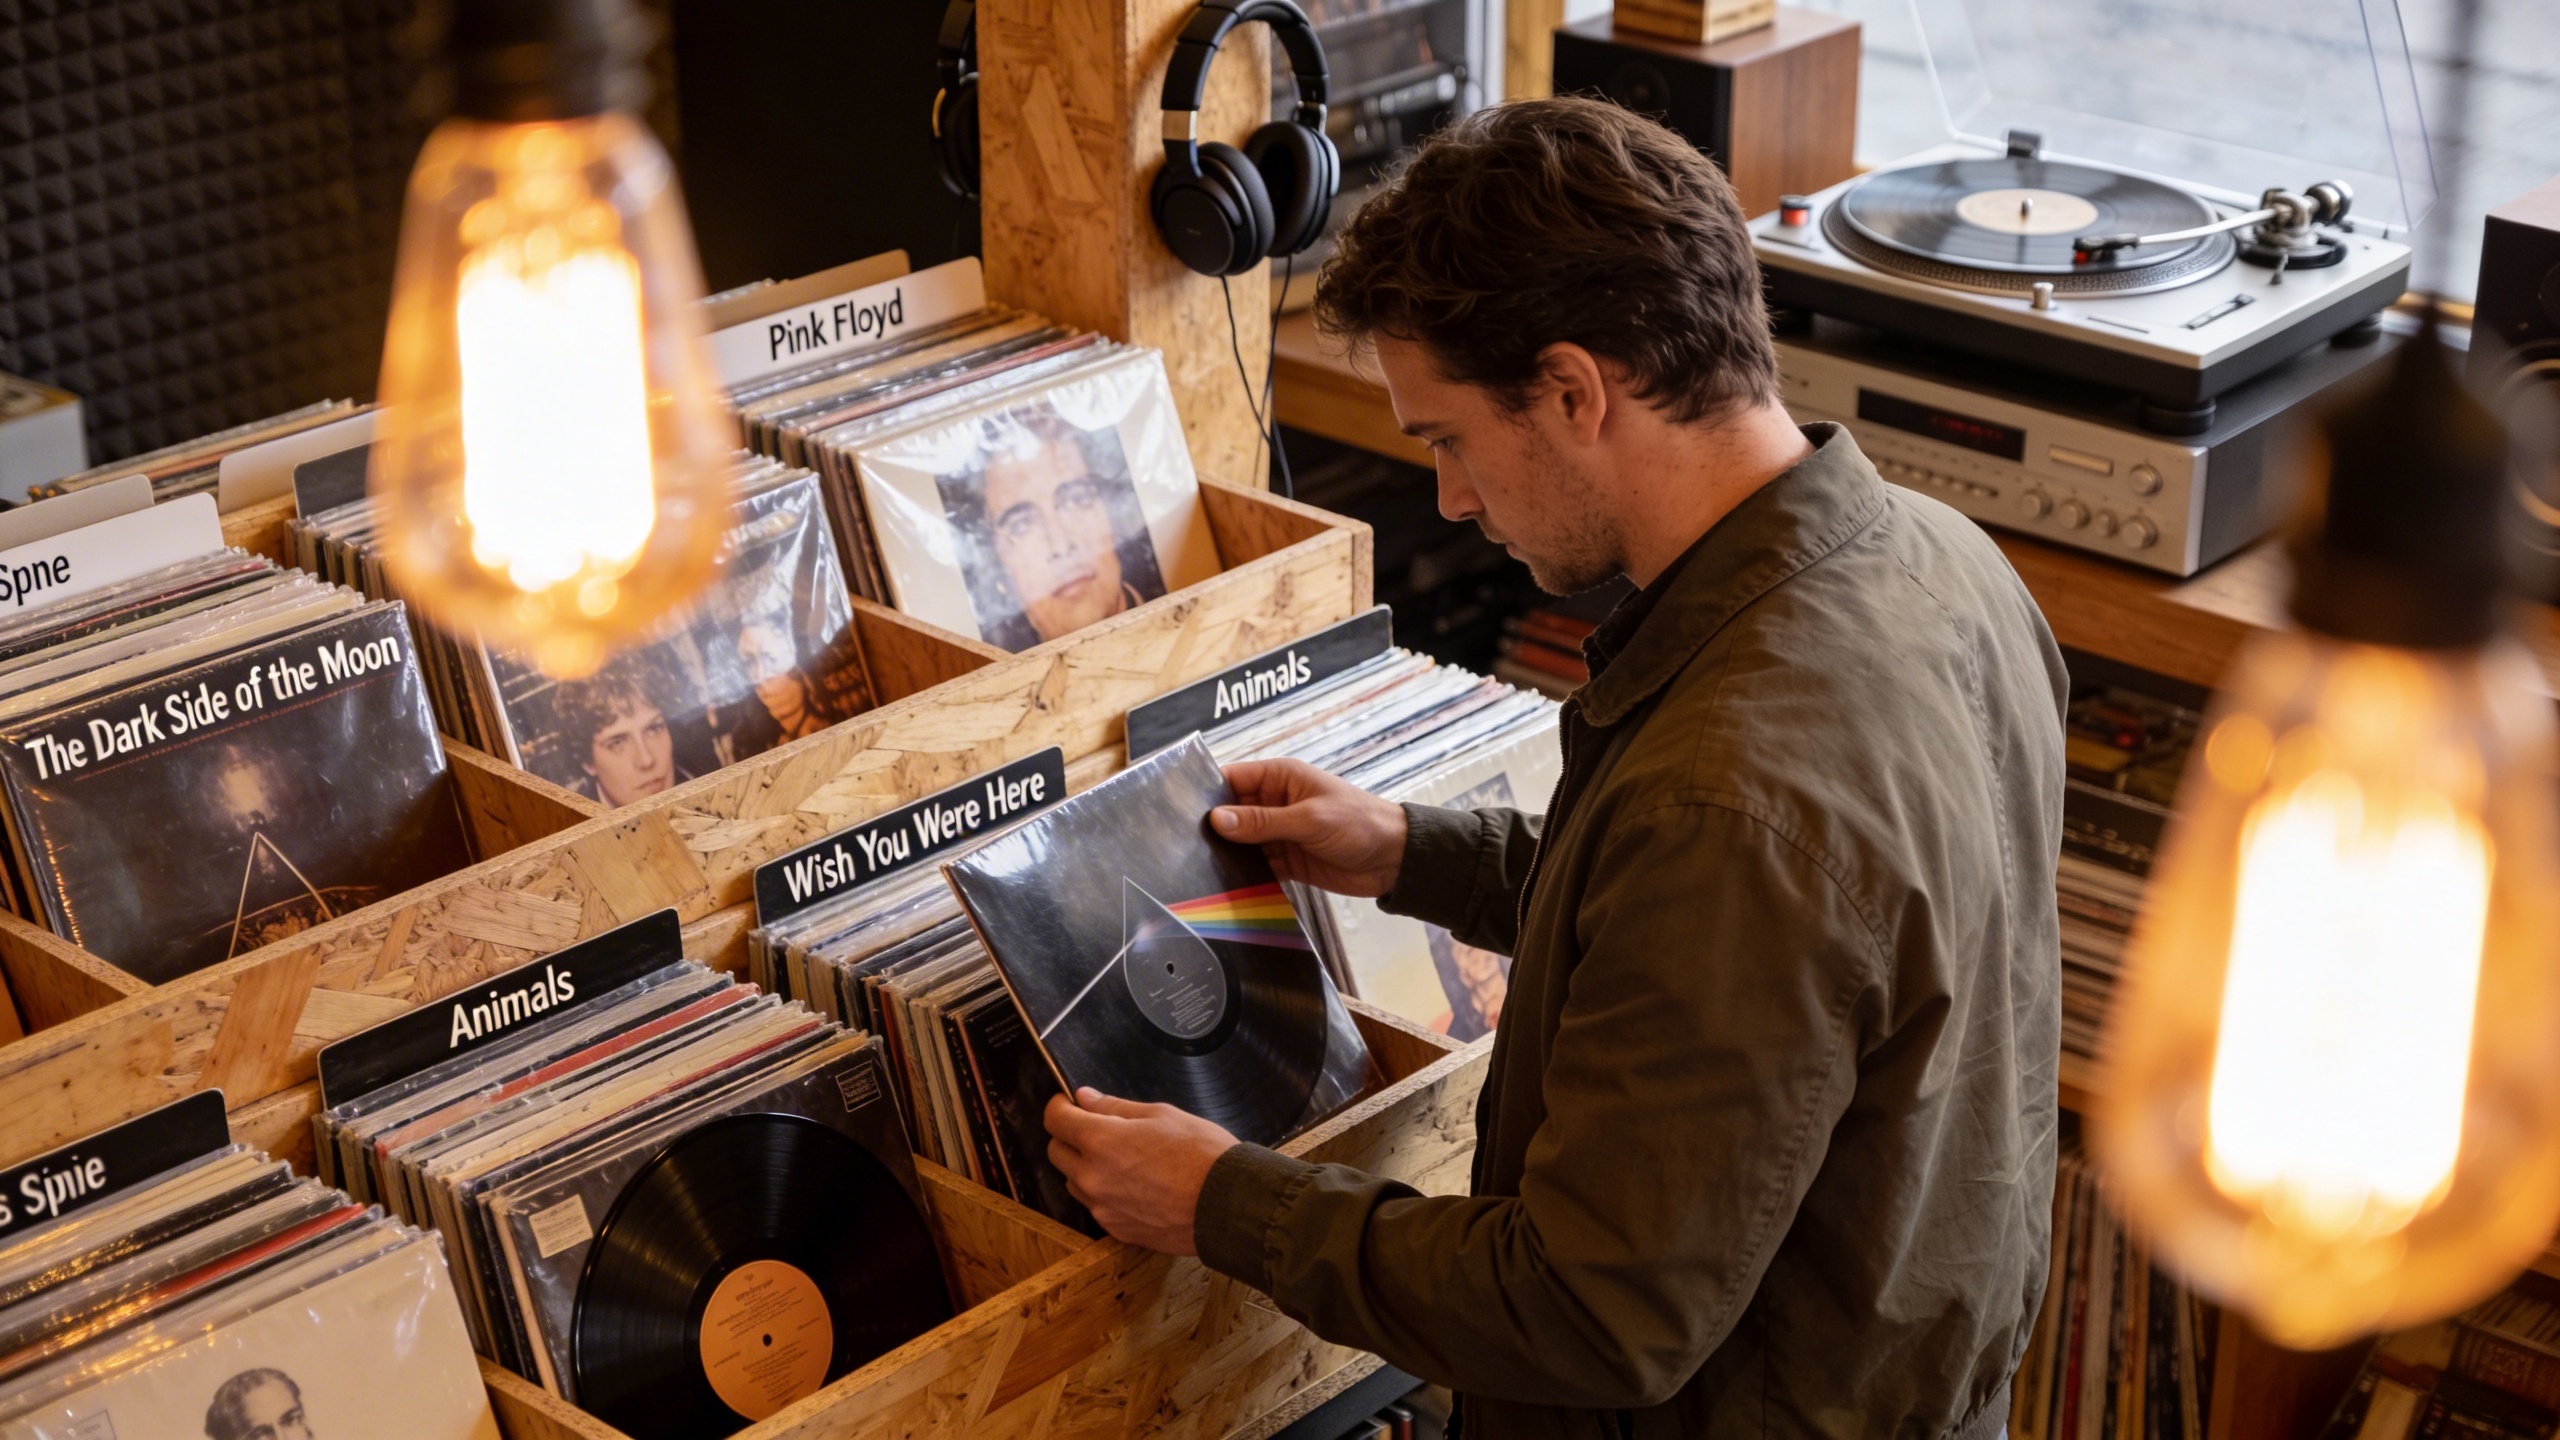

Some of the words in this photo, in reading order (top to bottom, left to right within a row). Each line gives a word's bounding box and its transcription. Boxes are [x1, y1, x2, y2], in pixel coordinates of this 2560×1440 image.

[769, 309, 828, 361] Pink
[833, 286, 903, 340] Floyd
[24, 737, 88, 780] The
[88, 704, 166, 761] Dark
[165, 683, 230, 736] Side
[235, 665, 264, 712] of
[268, 656, 318, 700] the
[317, 636, 402, 685] Moon
[1213, 649, 1312, 719] Animals
[783, 843, 856, 903] Wish
[856, 829, 910, 872] You
[912, 803, 981, 850] Were
[985, 772, 1045, 821] Here
[450, 964, 575, 1049] Animals
